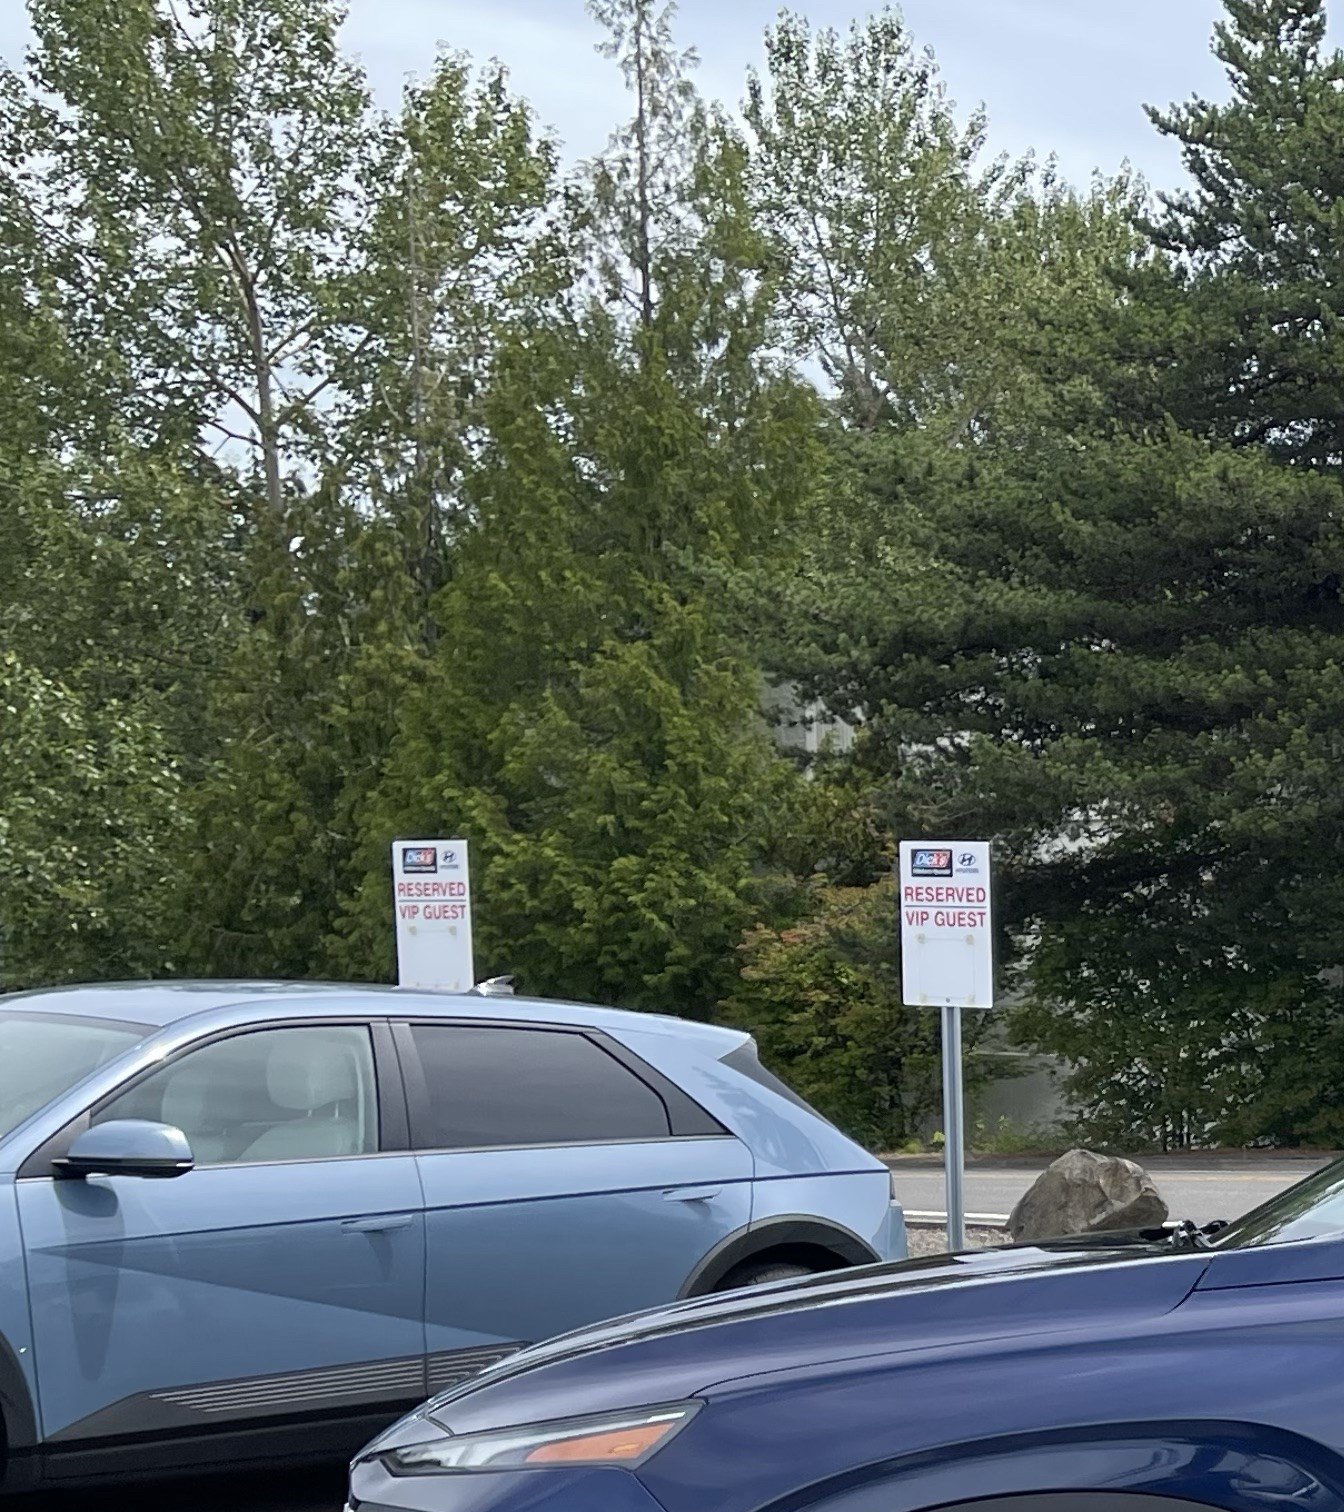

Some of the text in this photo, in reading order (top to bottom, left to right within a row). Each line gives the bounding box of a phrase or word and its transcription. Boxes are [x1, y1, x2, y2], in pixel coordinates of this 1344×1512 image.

[397, 882, 467, 898] RESERVED
[904, 886, 987, 903] RESERVED
[399, 904, 467, 920] VIP GUEST
[905, 911, 987, 927] VIP GUEST
